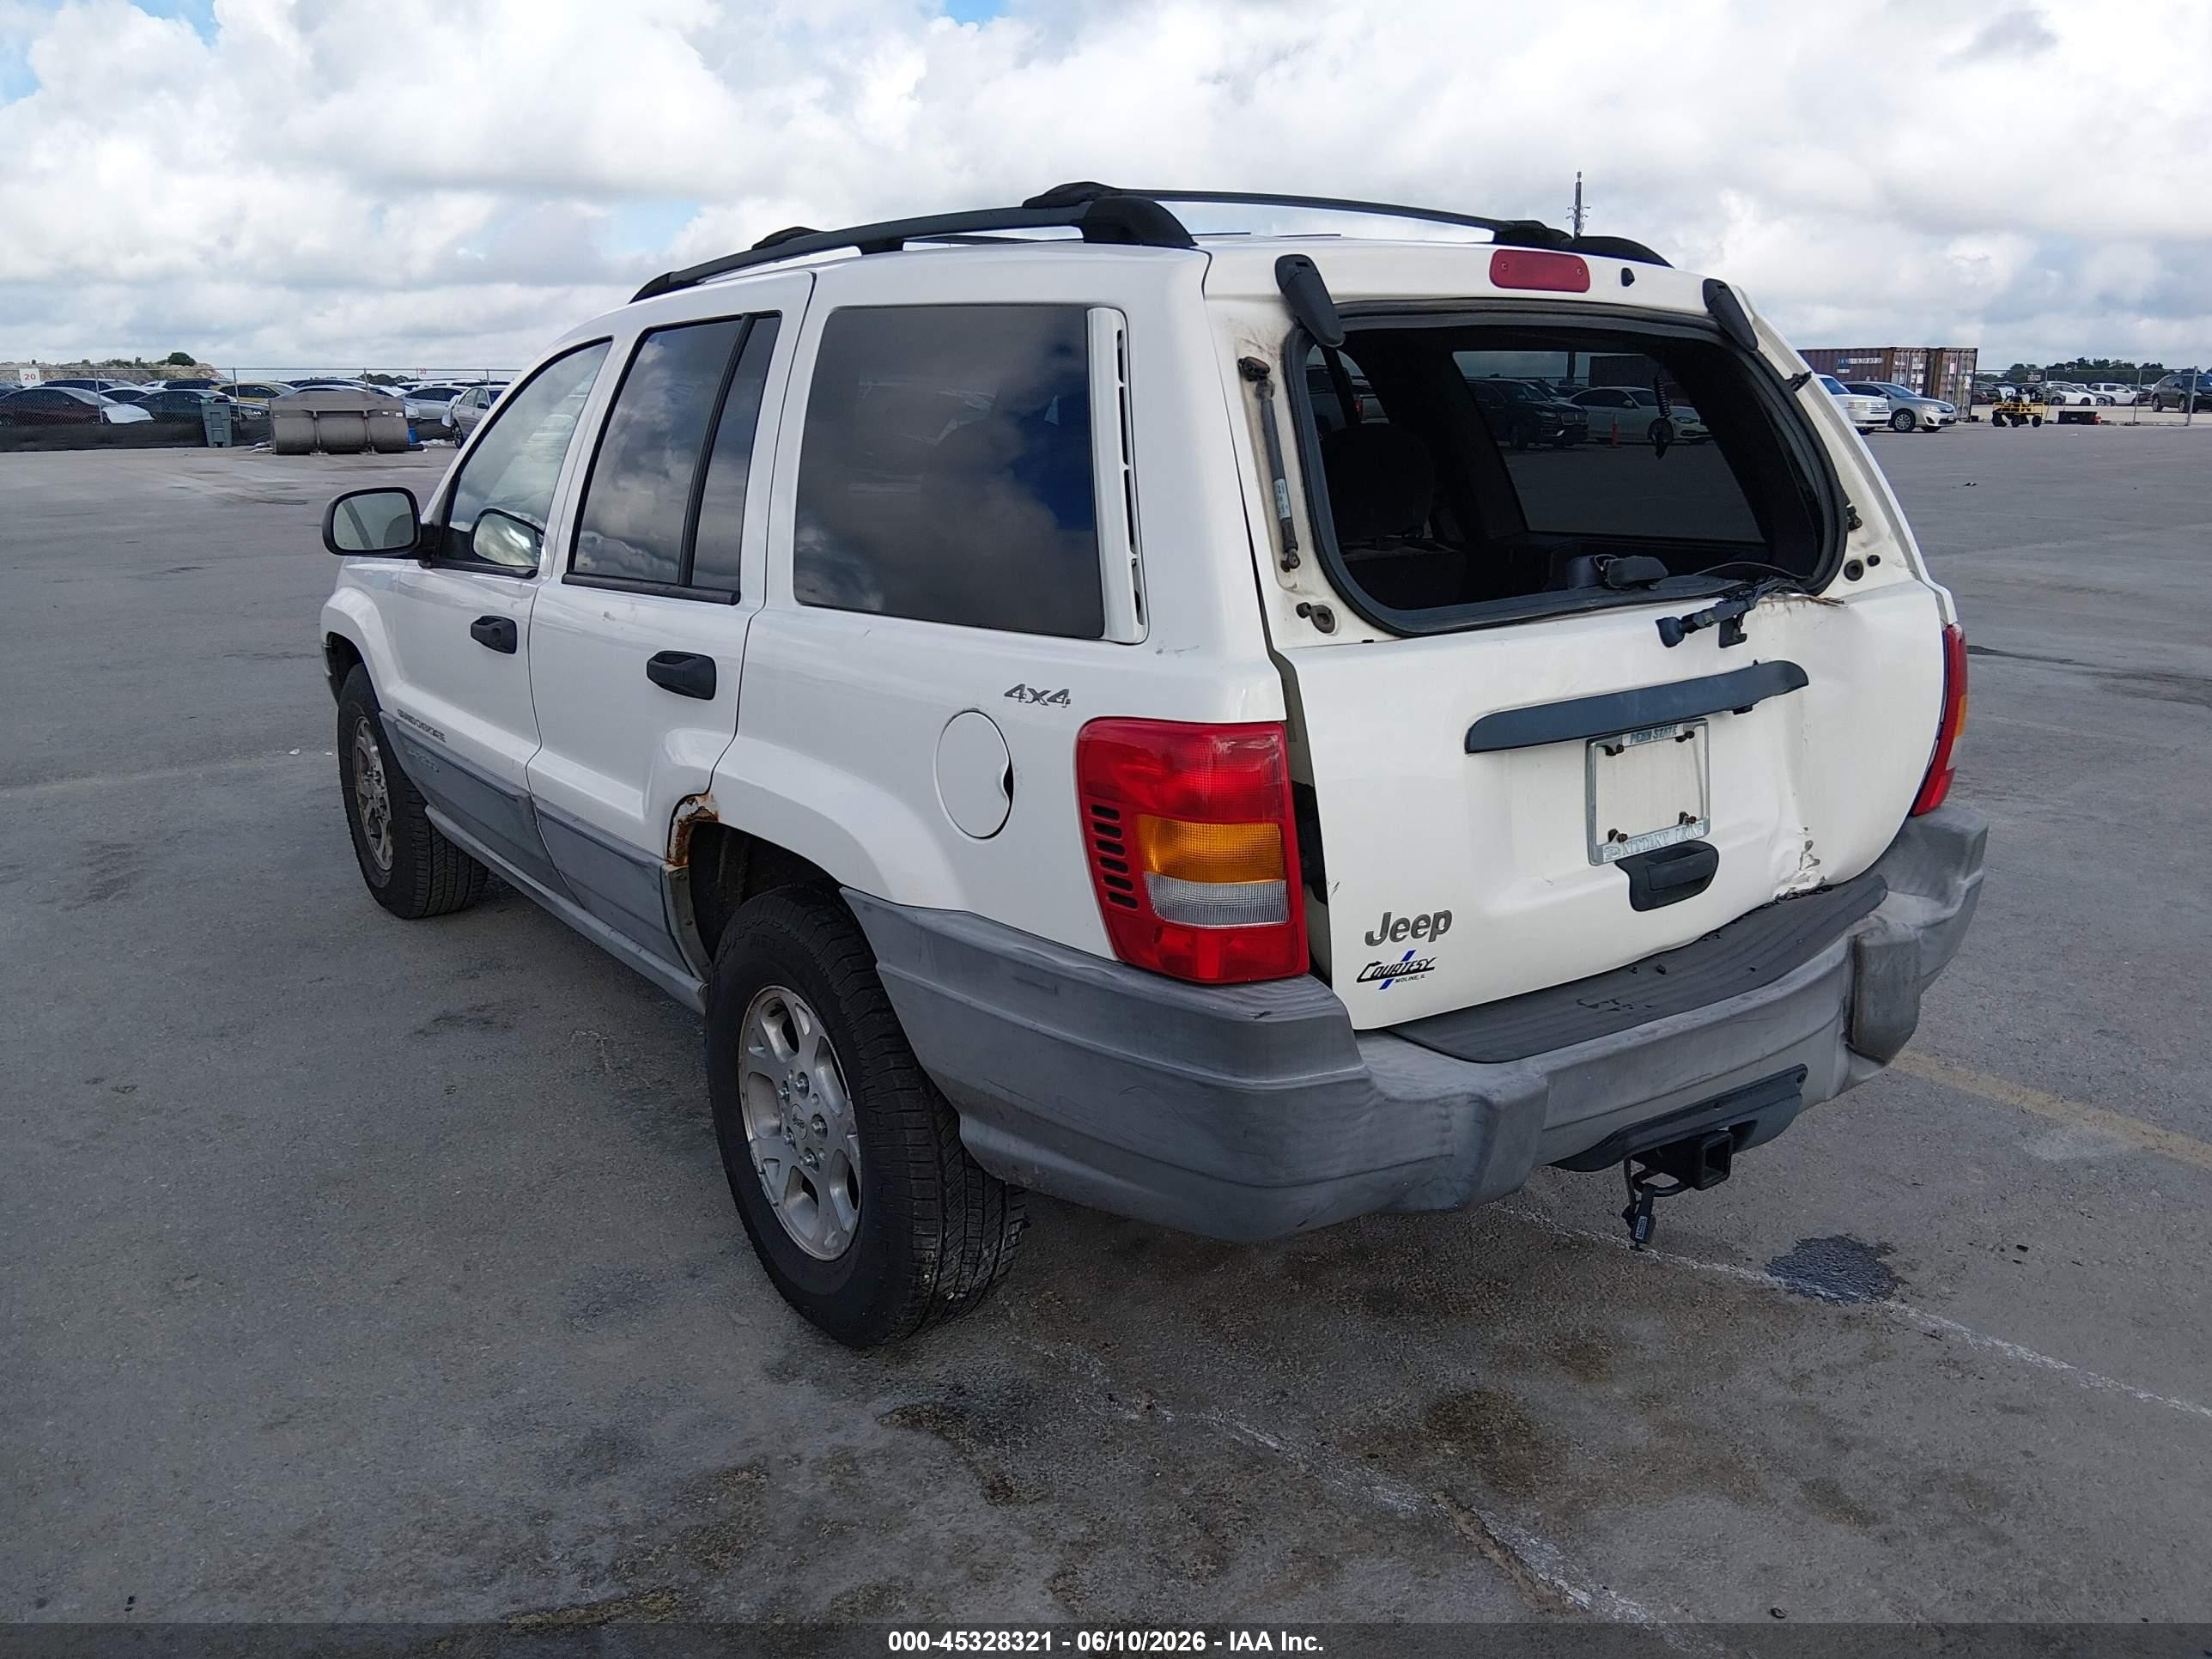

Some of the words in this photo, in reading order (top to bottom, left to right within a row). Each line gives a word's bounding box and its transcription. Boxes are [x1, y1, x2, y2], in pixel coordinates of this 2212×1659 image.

[1630, 730, 1652, 744] PENN
[1652, 724, 1678, 739] STATE
[1364, 909, 1452, 947] Jeep
